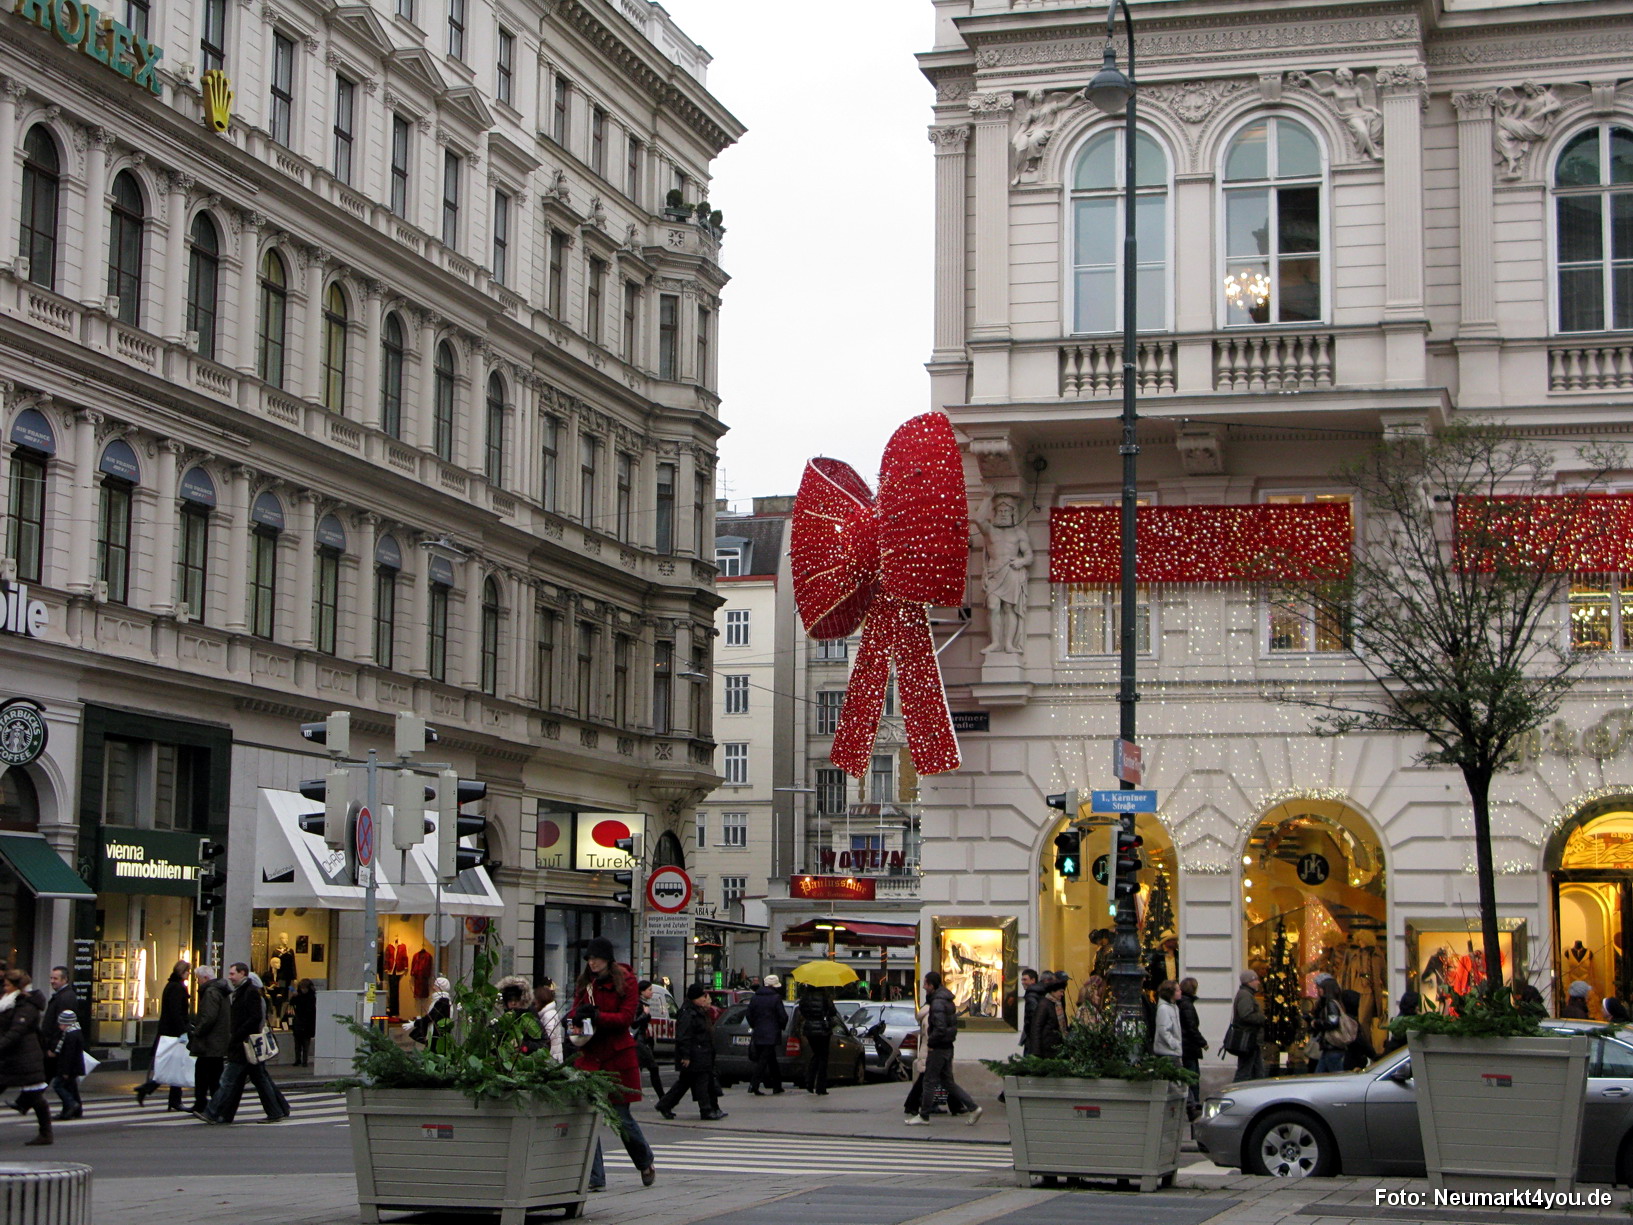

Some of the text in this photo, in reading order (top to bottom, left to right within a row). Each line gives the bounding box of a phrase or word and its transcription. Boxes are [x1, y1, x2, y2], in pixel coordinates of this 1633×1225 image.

[1112, 793, 1147, 801] Kärntner
[1112, 802, 1136, 810] Straße
[106, 840, 144, 860] vienna
[116, 859, 182, 879] immobilien
